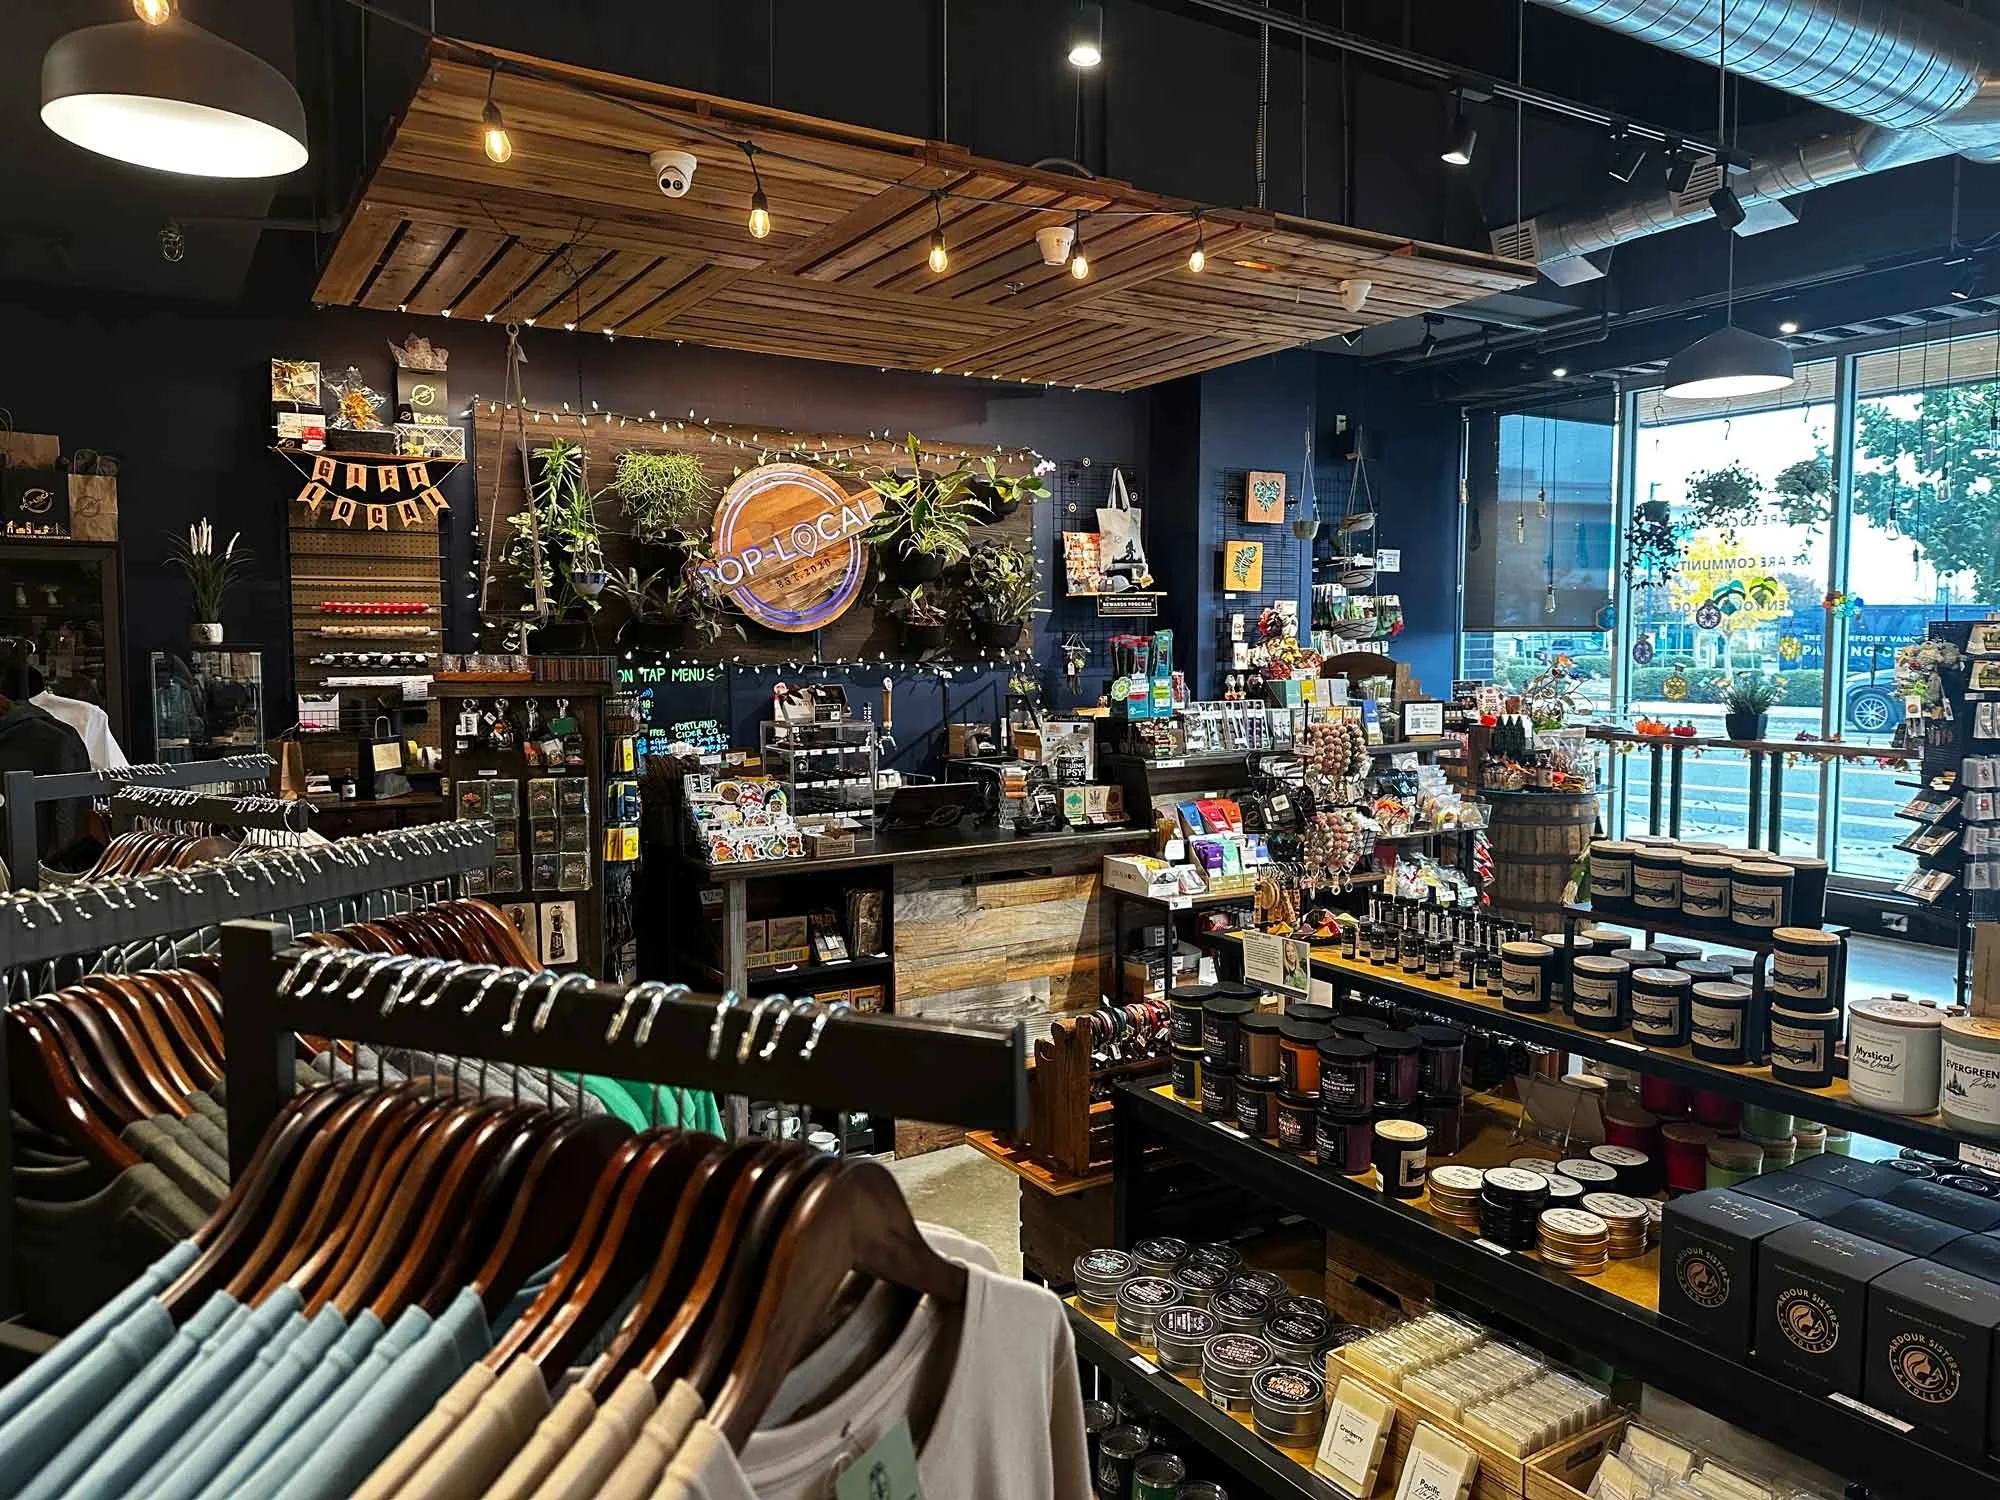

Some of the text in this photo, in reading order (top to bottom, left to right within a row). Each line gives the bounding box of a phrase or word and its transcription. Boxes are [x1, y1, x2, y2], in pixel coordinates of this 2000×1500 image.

[318, 460, 423, 485] GIFT
[306, 486, 441, 523] LOCAL
[643, 667, 666, 682] TAP
[671, 667, 705, 682] MENU
[675, 719, 718, 732] PORTLAND
[676, 729, 703, 739] CIDER
[1855, 1045, 1894, 1063] Mystical
[1946, 1059, 2000, 1080] EVERGREEN
[1777, 1288, 1810, 1307] ARDOUR
[1889, 1332, 1961, 1377] ARDOUR SISTERZ
[1419, 1478, 1441, 1497] Pacific
